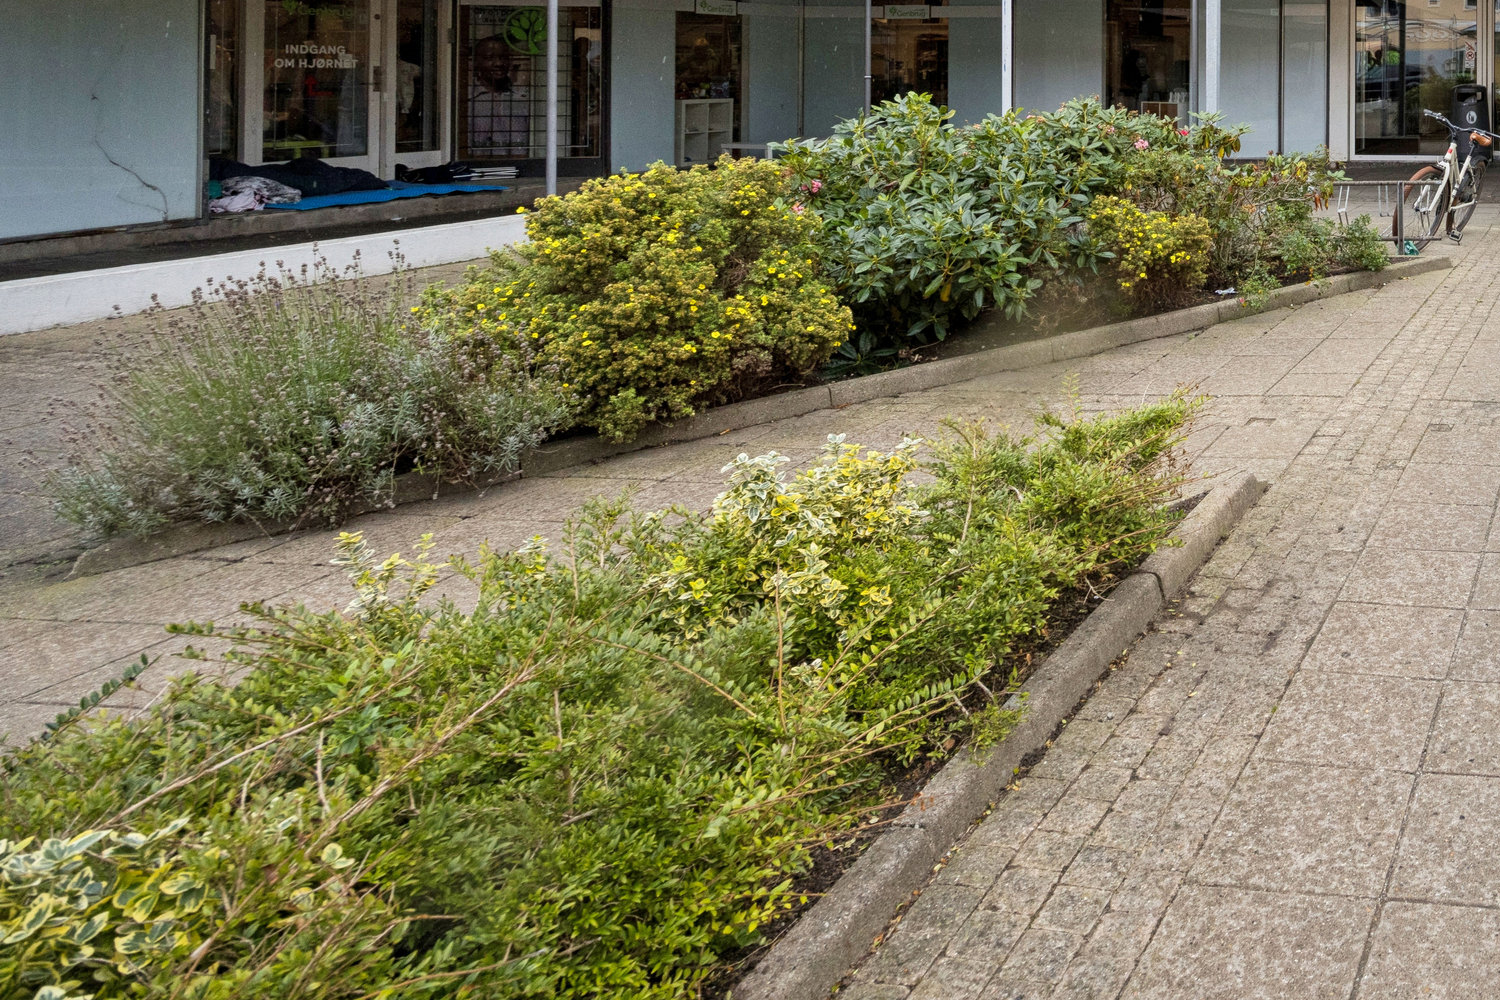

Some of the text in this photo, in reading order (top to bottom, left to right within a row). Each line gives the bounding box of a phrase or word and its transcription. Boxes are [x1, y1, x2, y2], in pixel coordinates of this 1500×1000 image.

[285, 44, 346, 55] INDGANG
[274, 58, 358, 69] OM HJØRNET
